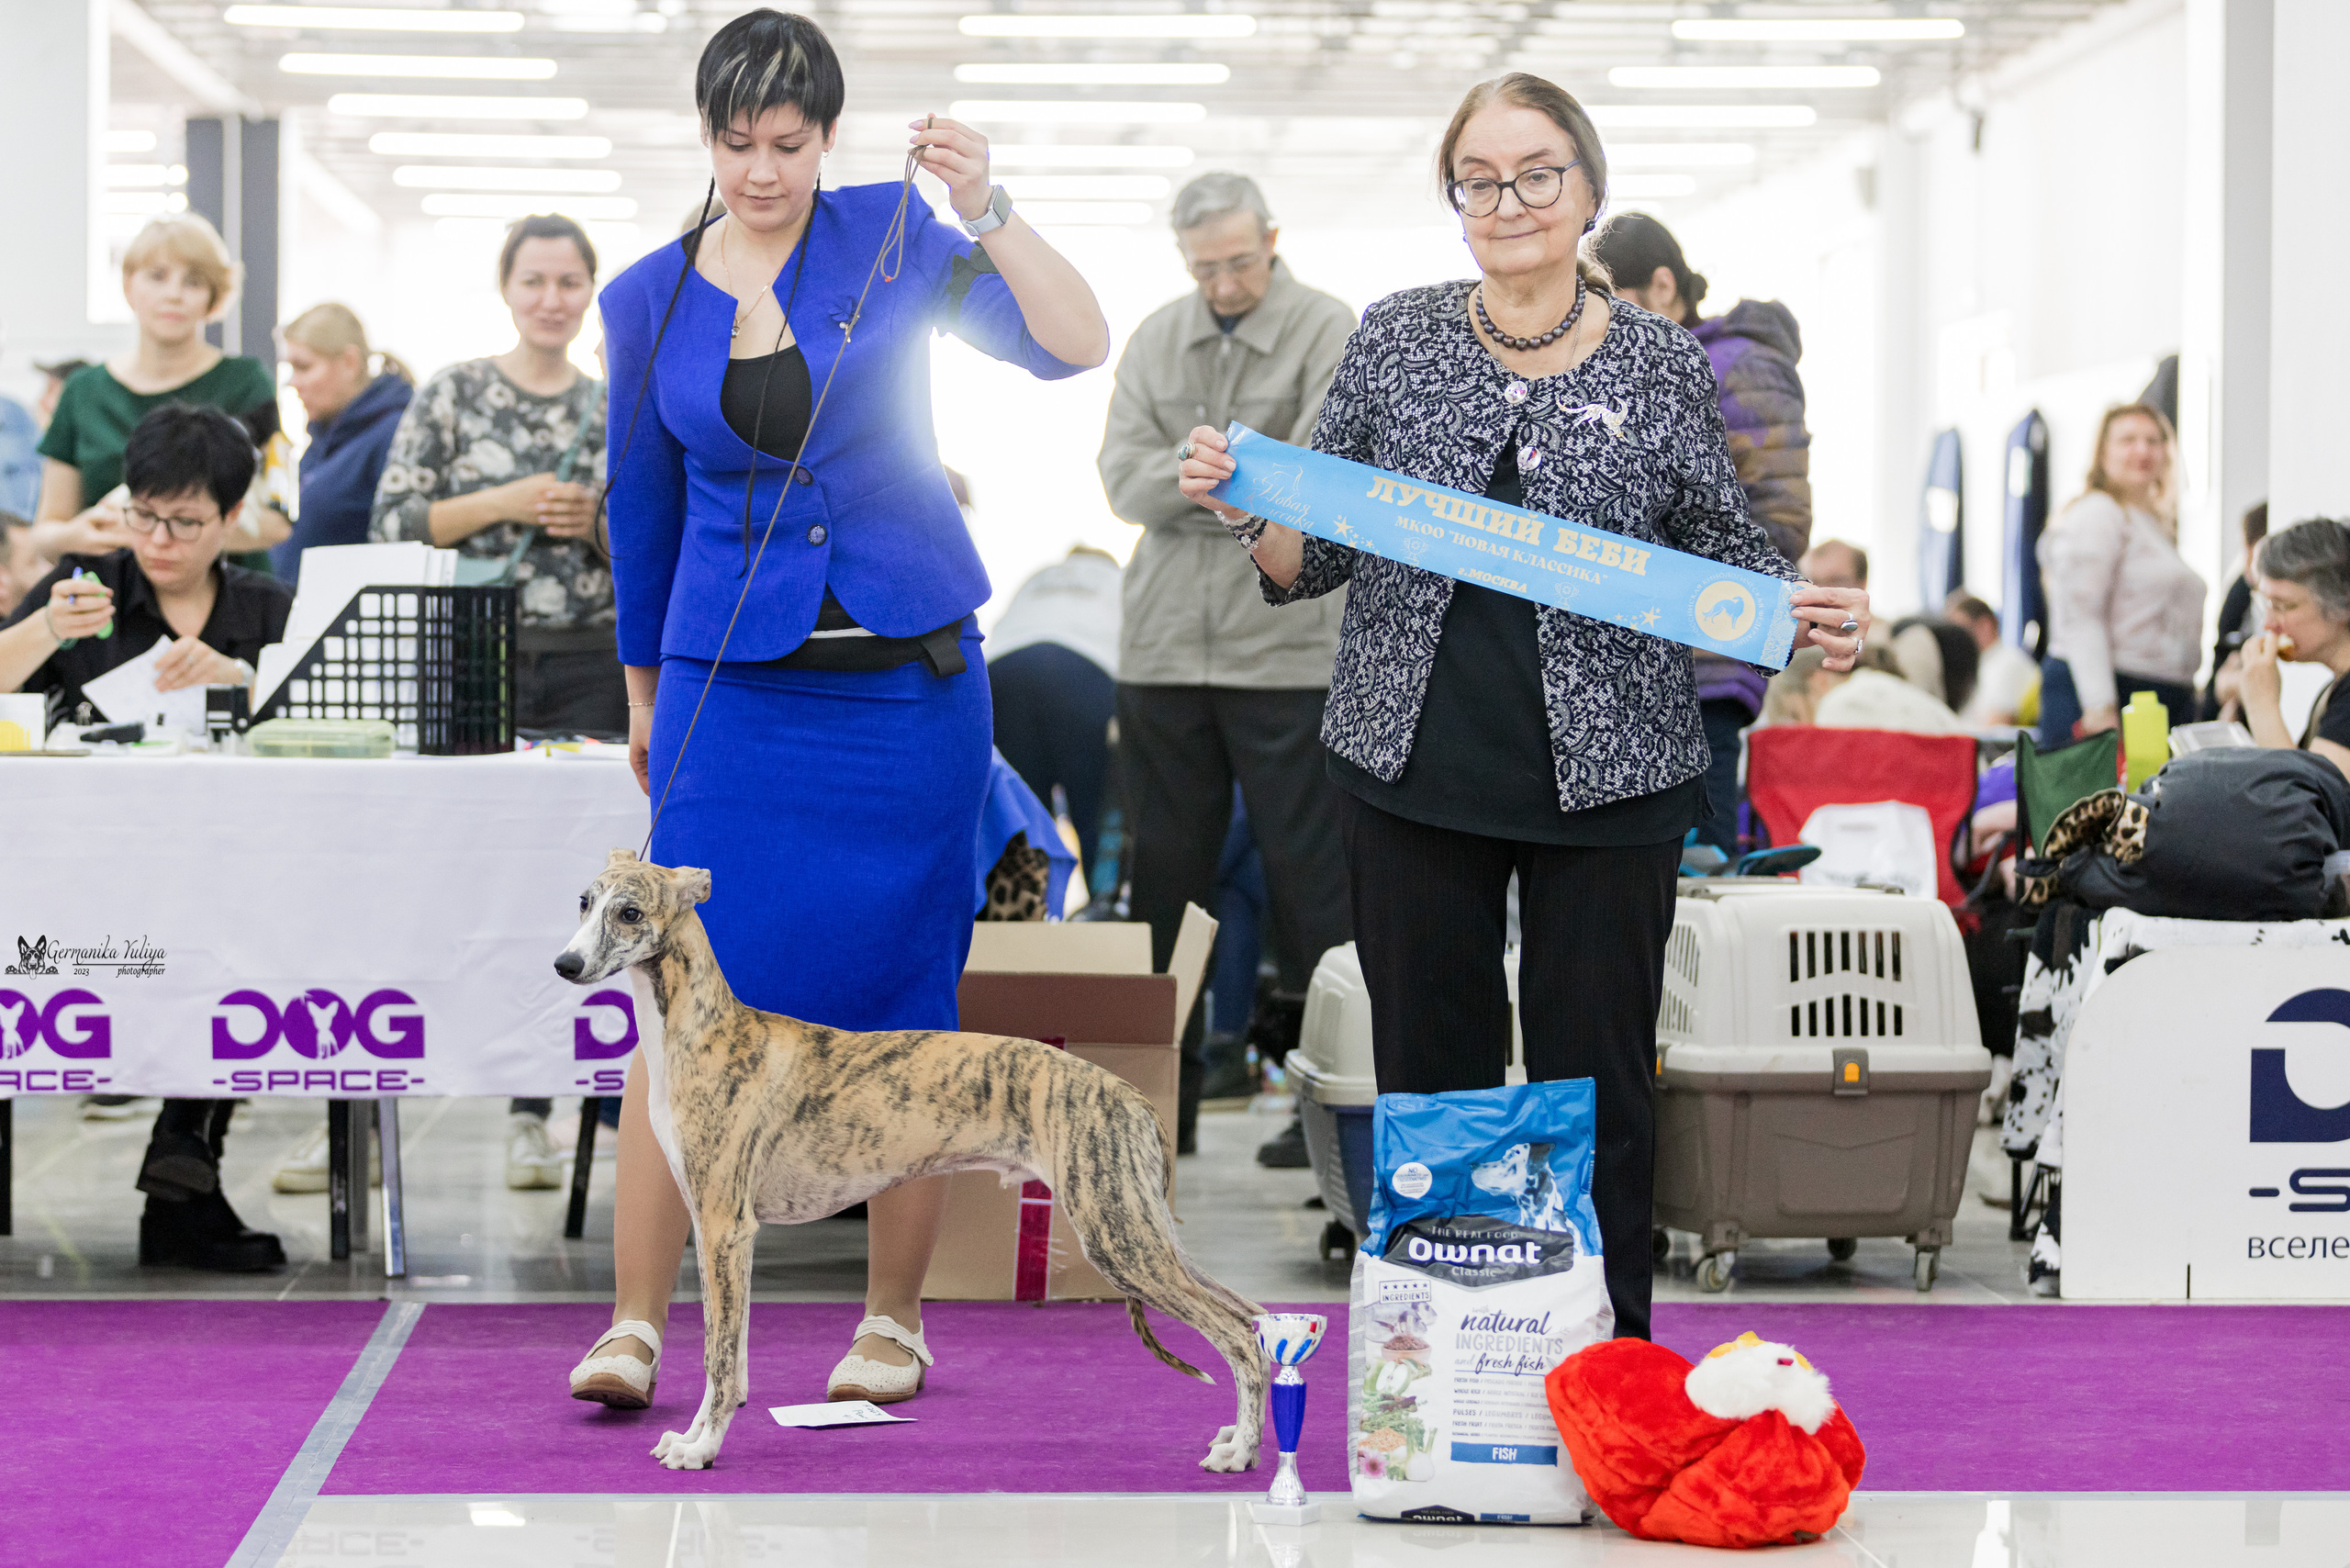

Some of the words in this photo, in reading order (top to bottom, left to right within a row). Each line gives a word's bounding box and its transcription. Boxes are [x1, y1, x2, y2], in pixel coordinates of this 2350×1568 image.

[1366, 475, 1546, 546] ЛУЧШИЙ
[1552, 526, 1651, 577] БЕБИ
[1393, 515, 1446, 539] МКОО
[1449, 530, 1511, 558] "НОВАЯ
[1512, 548, 1608, 585] КЛАССИКА"
[1457, 566, 1528, 594] г.МОСКВА
[211, 988, 425, 1059] DOG
[1455, 1228, 1482, 1238] REAL
[1486, 1230, 1518, 1239] FOOD
[2247, 1236, 2350, 1260] вселе
[1450, 1265, 1497, 1277] Classic
[1382, 1291, 1430, 1303] INGREDIENTS
[1460, 1309, 1553, 1335] natural
[1455, 1333, 1564, 1356] INGREDIENTS
[1454, 1354, 1476, 1366] and
[1474, 1352, 1515, 1374] fresh
[1515, 1353, 1548, 1376] fish
[1492, 1447, 1518, 1461] FISH
